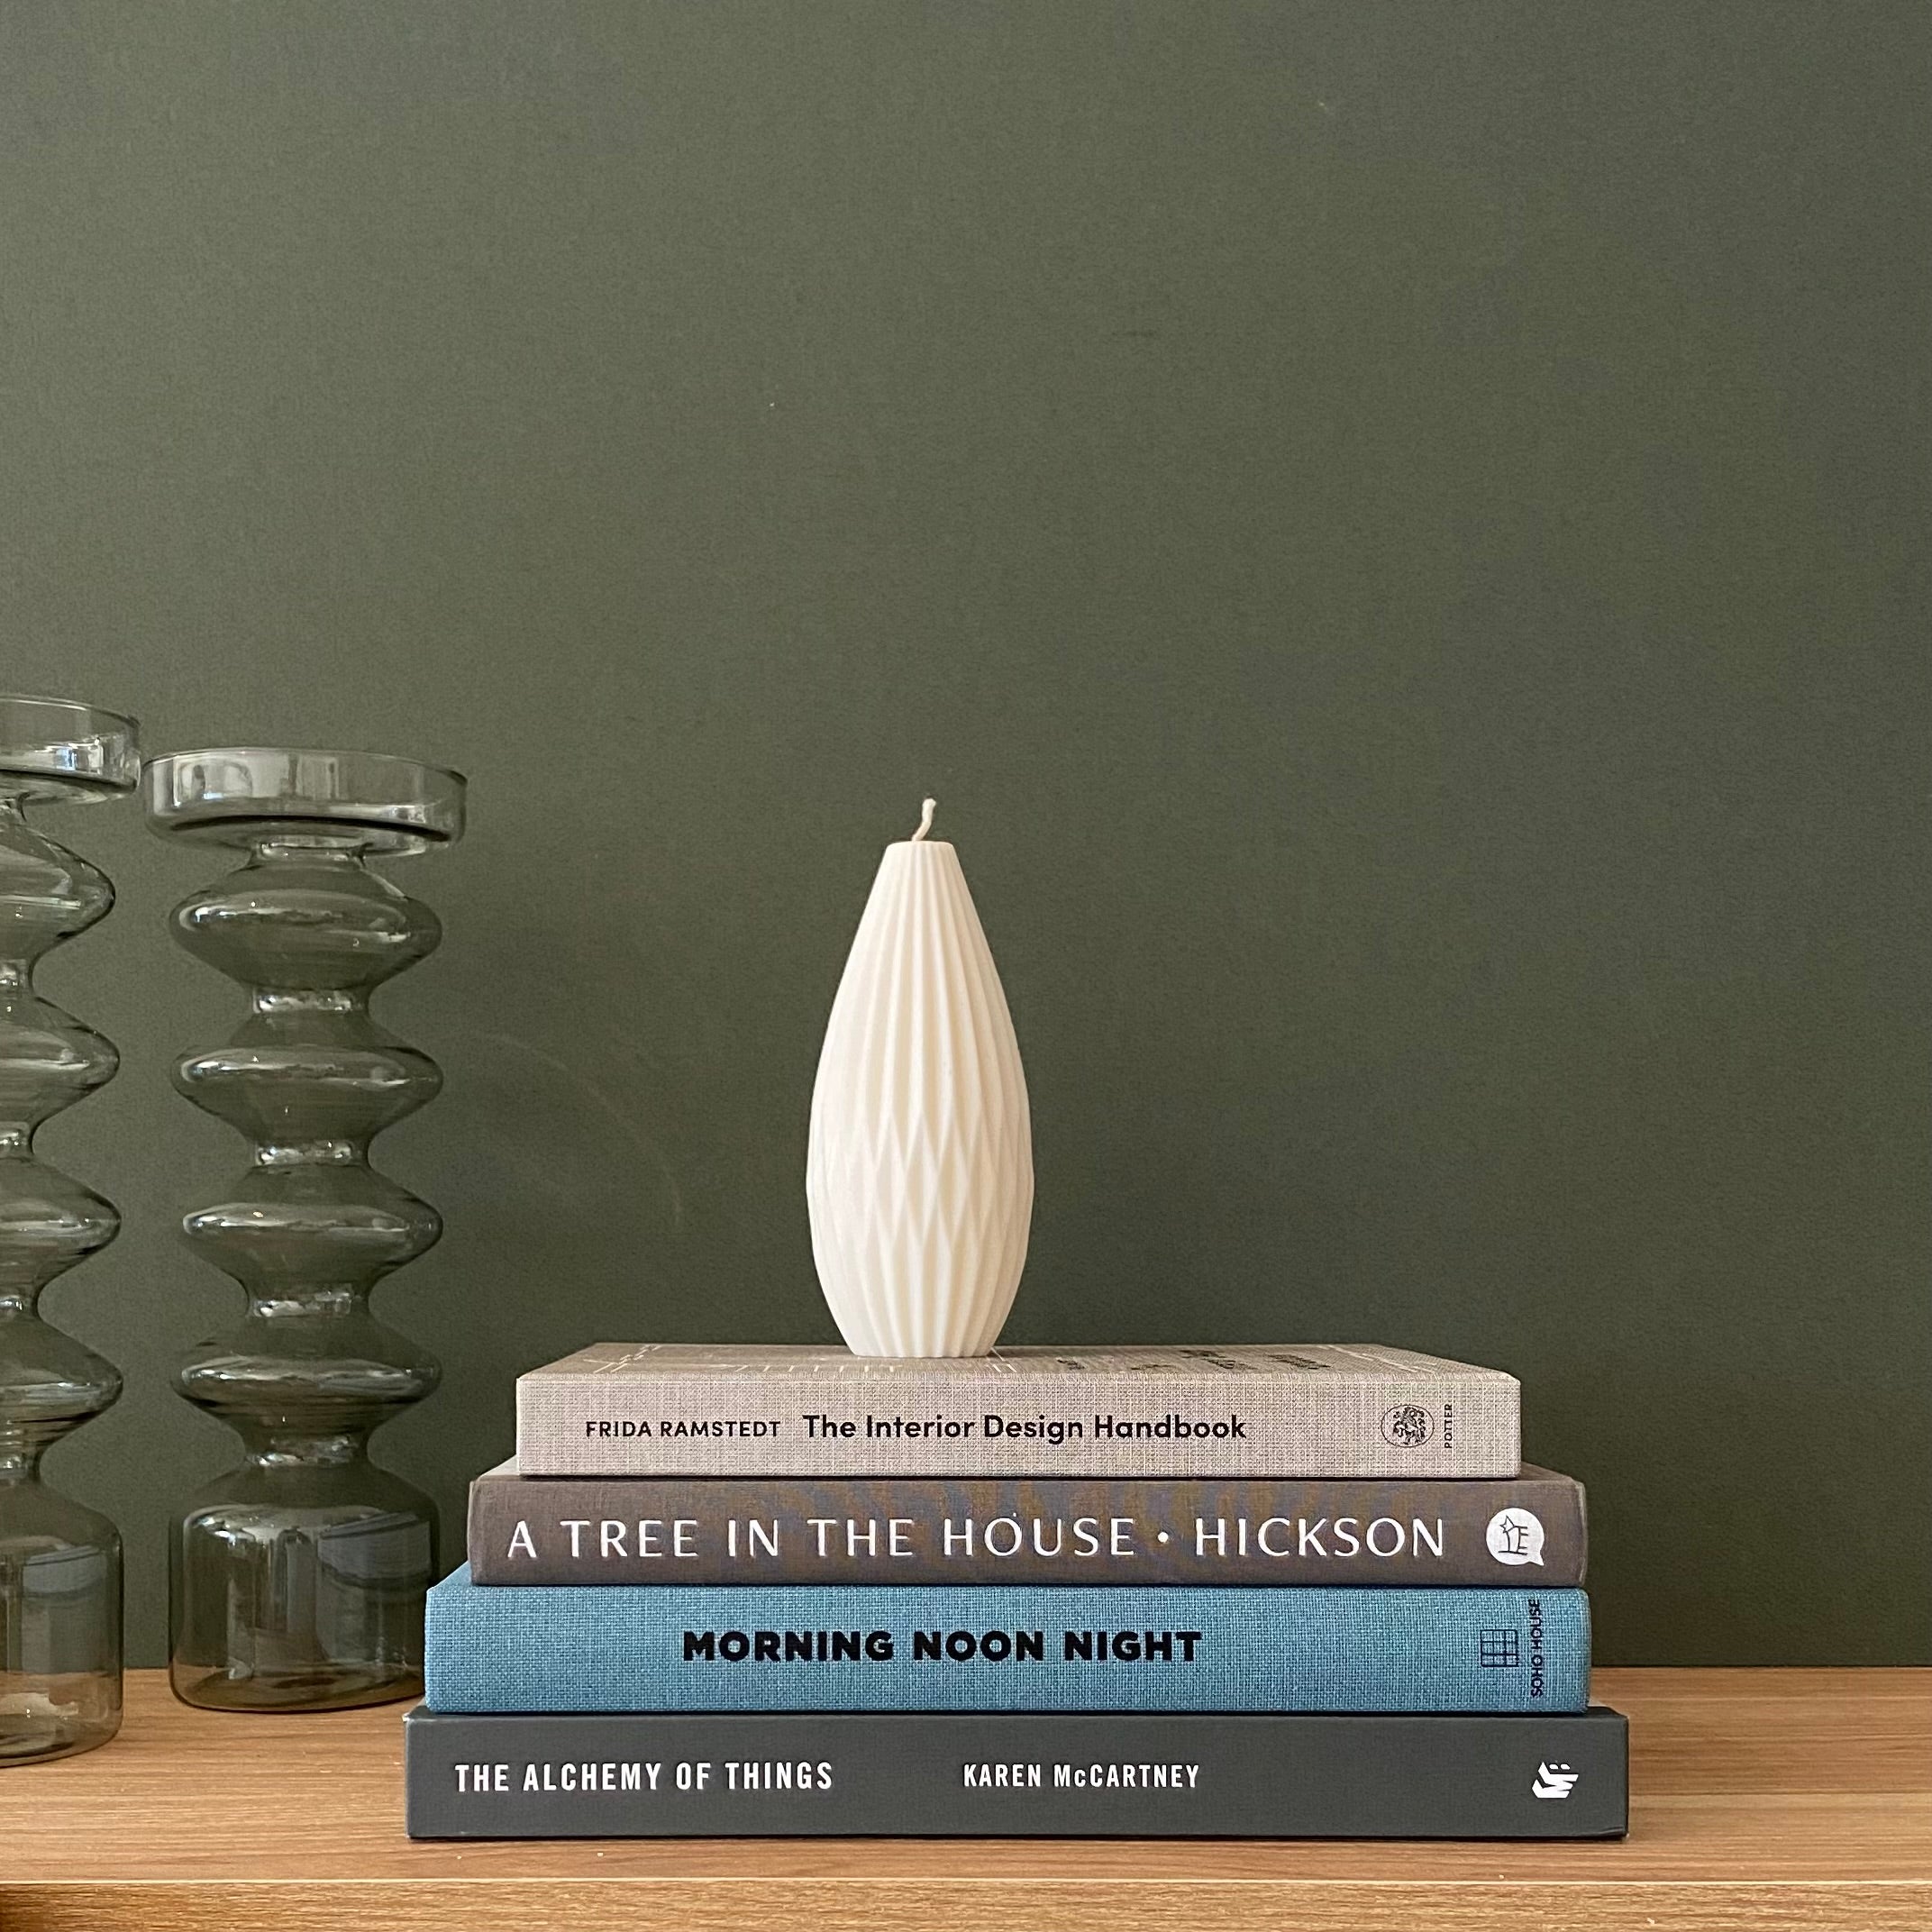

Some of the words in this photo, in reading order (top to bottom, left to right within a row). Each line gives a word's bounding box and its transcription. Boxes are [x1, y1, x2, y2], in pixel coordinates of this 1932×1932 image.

[586, 1421, 652, 1437] FRIDA
[661, 1420, 781, 1437] RAMSTEDT
[802, 1414, 857, 1438] The
[866, 1414, 976, 1438] Interior
[984, 1414, 1083, 1445] Design
[1094, 1414, 1247, 1439] Handbook
[1444, 1403, 1454, 1449] POTTER
[507, 1520, 538, 1558] A
[560, 1519, 698, 1558] TREE
[728, 1519, 779, 1557] IN
[807, 1518, 915, 1557] THE
[943, 1517, 1135, 1557] HOUSE
[1195, 1517, 1444, 1557] HICKSON
[1528, 1599, 1544, 1650] HOUSE
[683, 1630, 894, 1663] MORNING
[913, 1629, 1043, 1663] NOON
[1064, 1629, 1202, 1663] NIGHT
[1530, 1654, 1545, 1699] SOHO
[454, 1763, 510, 1792] THE
[523, 1763, 661, 1791] ALCHEMY
[676, 1762, 712, 1791] OF
[724, 1761, 834, 1791] THINGS
[963, 1763, 1042, 1788] KAREN
[1053, 1763, 1199, 1789] McCARTNEY
